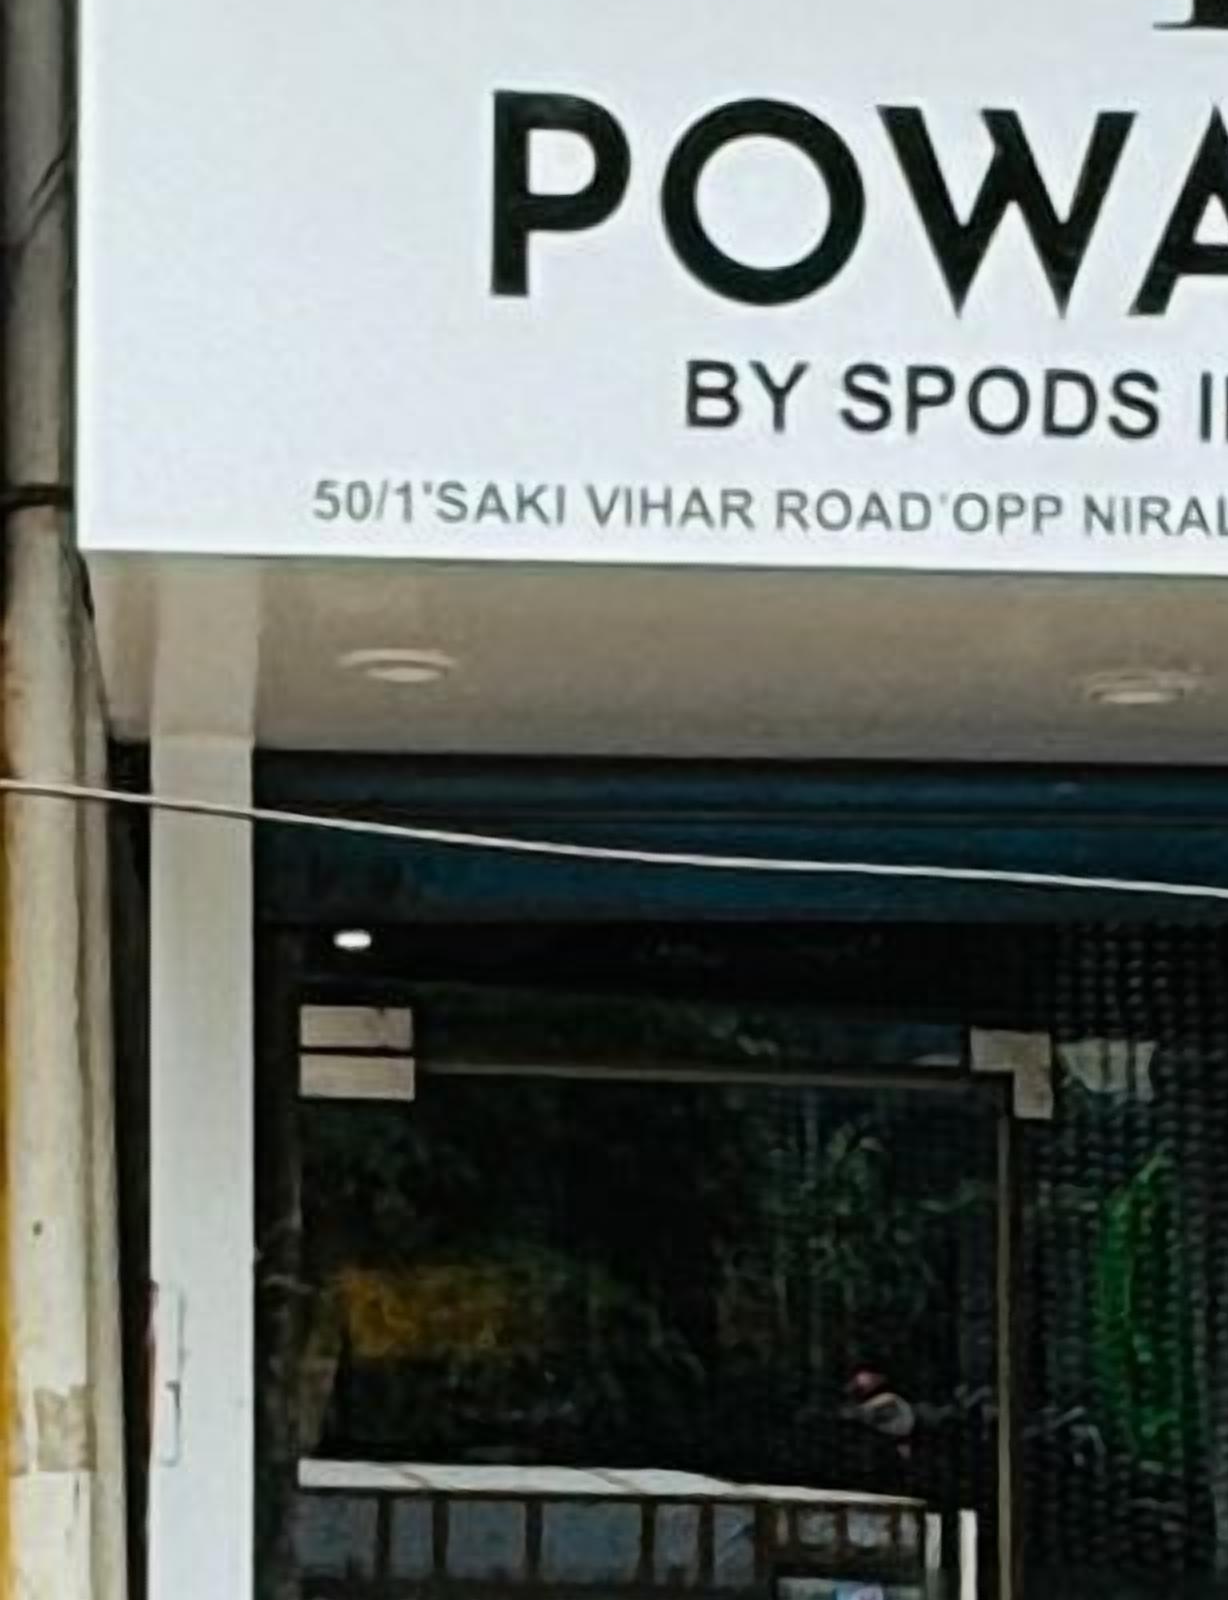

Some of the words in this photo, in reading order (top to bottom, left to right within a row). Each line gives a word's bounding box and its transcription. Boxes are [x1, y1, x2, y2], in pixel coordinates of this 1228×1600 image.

[685, 358, 810, 434] BY
[838, 361, 1161, 441] SPODS
[584, 483, 756, 531] VIHAR
